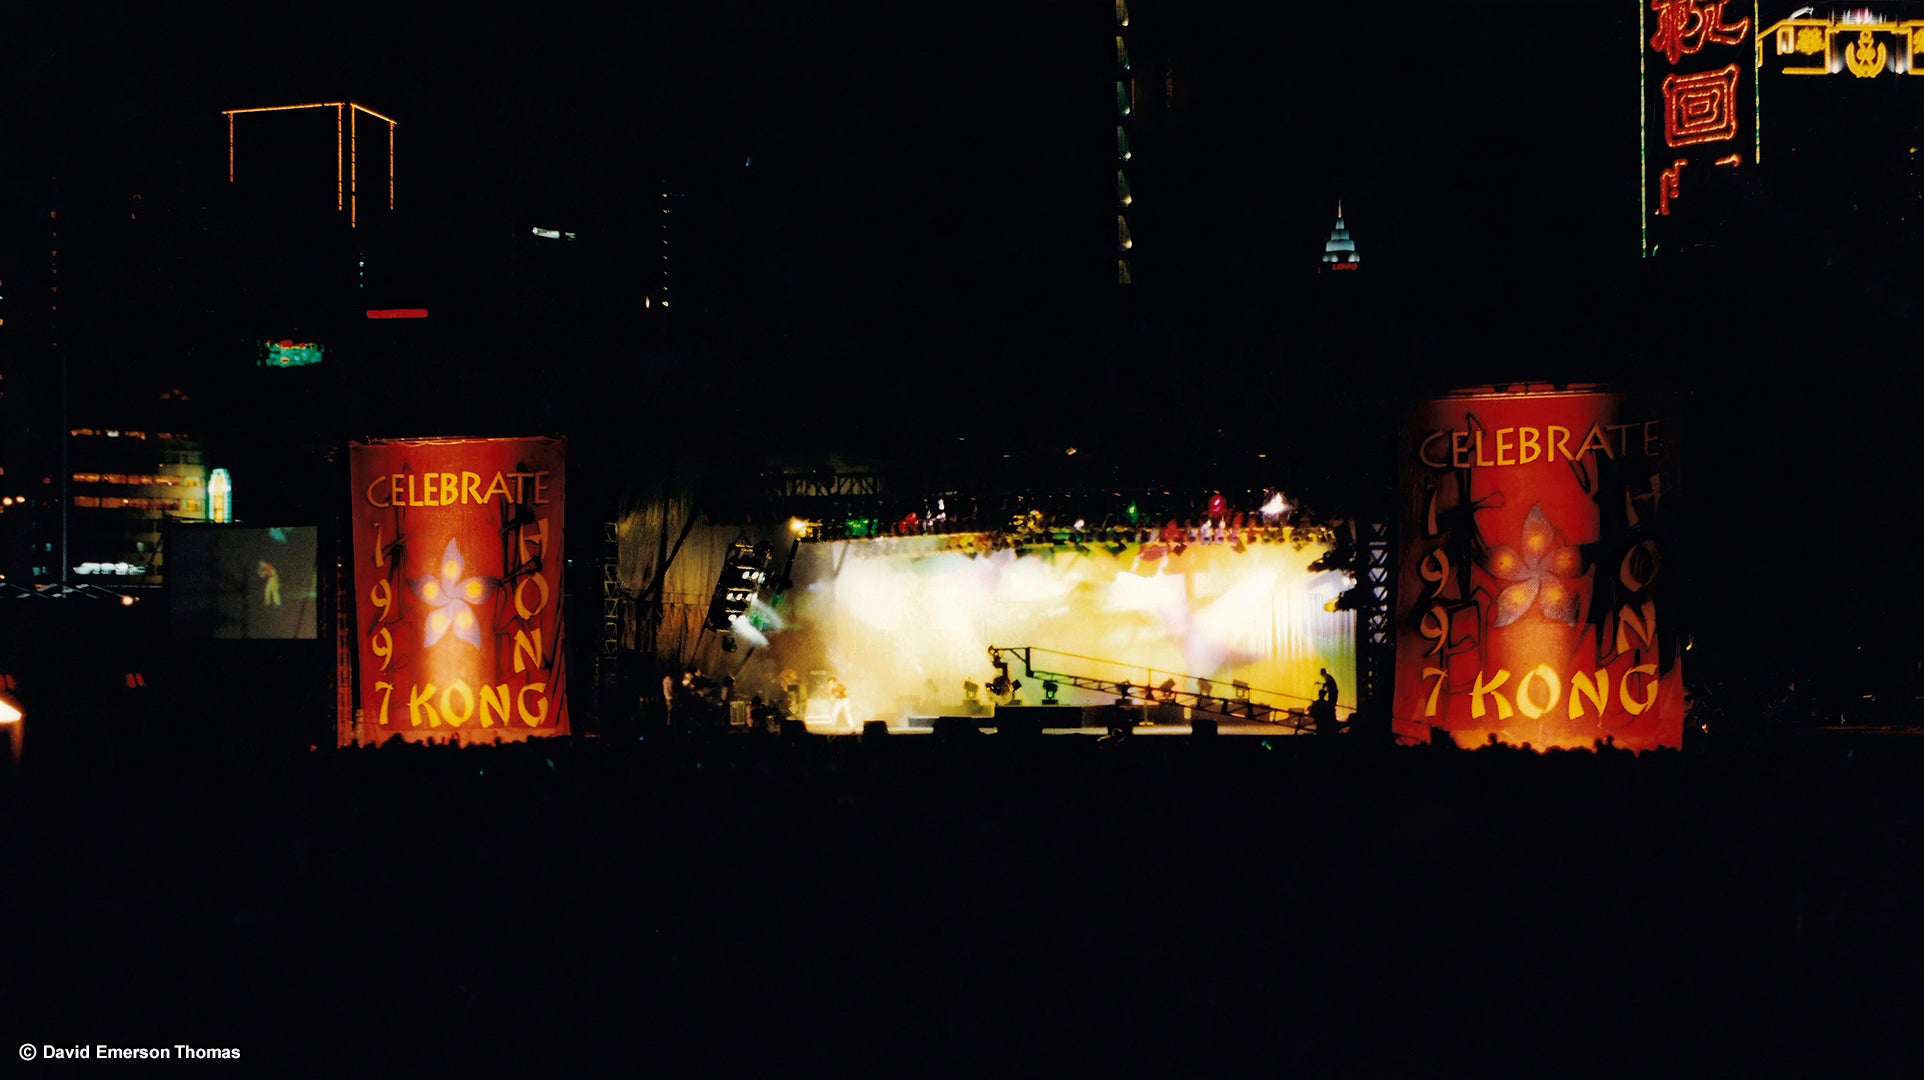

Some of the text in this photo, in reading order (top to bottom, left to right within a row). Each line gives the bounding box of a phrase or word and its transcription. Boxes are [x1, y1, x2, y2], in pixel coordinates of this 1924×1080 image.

[1419, 418, 1662, 469] CELEBRATE
[367, 470, 549, 508] CELEBRATE
[370, 522, 394, 726] 1997
[1420, 483, 1449, 718] 1997
[408, 678, 549, 729] KONG
[1468, 663, 1659, 721] KONG
